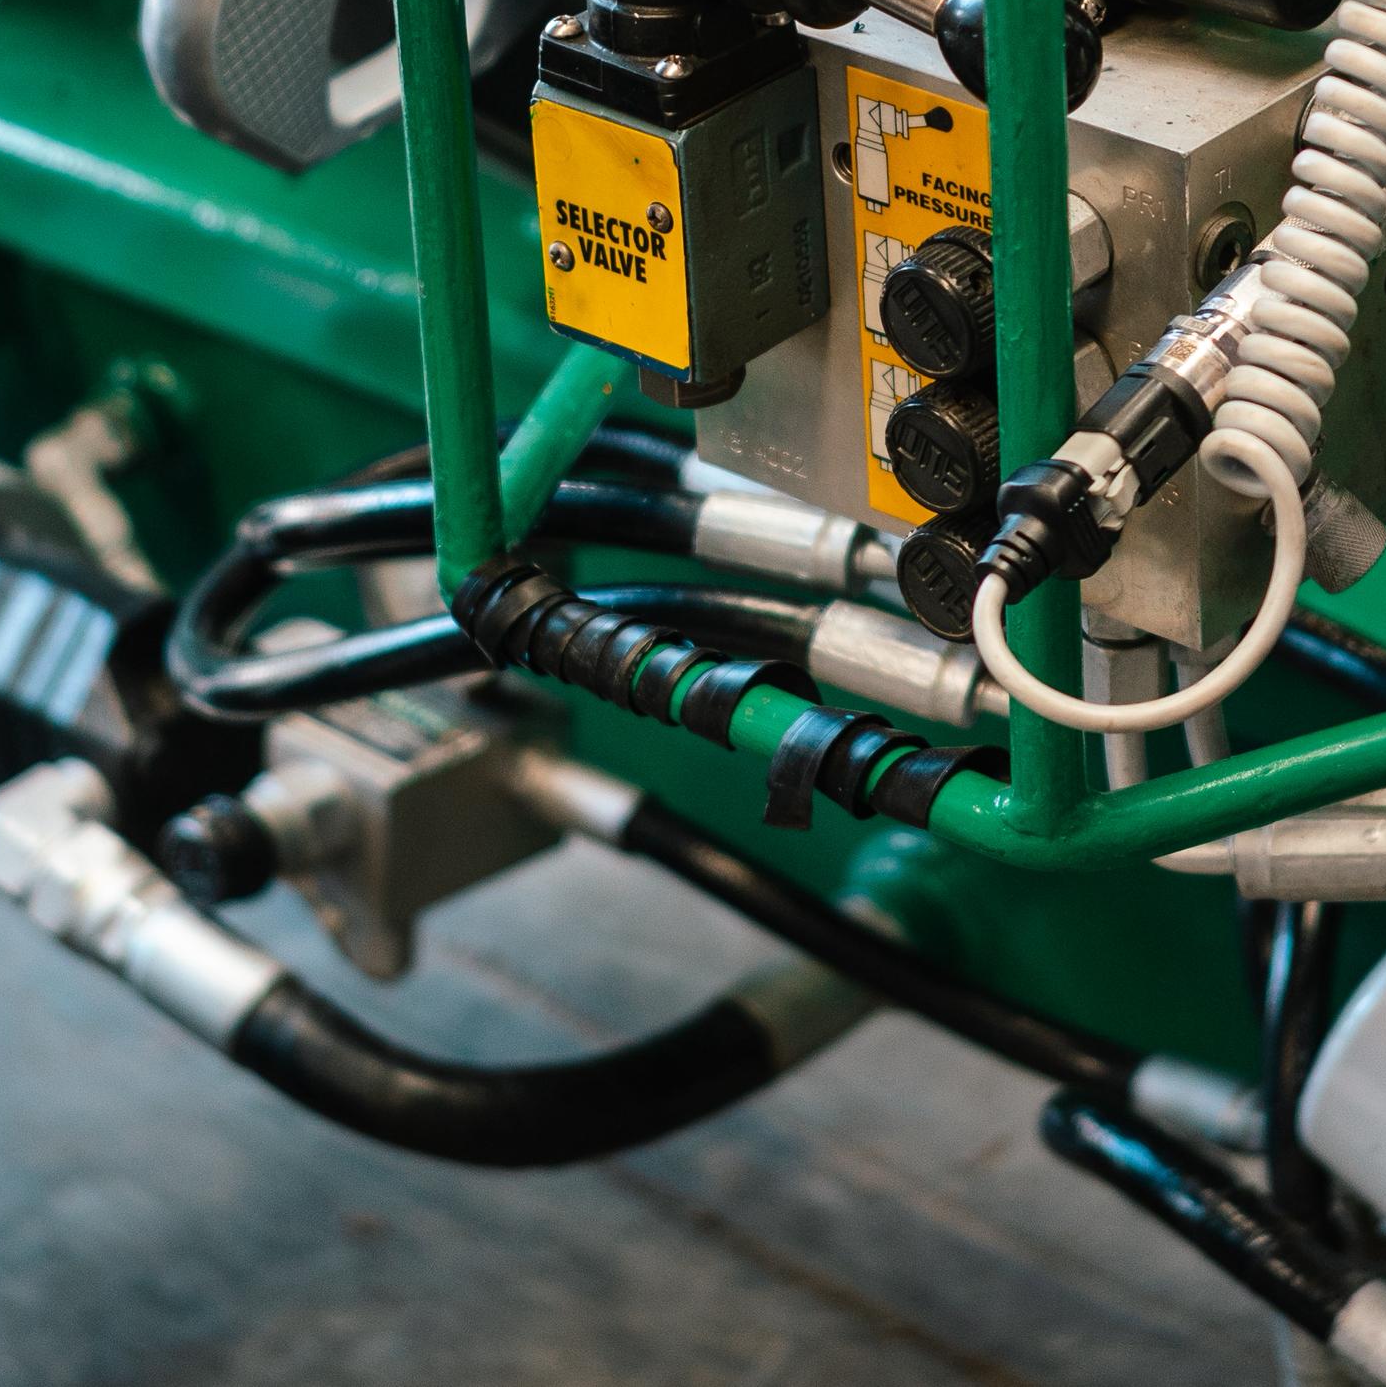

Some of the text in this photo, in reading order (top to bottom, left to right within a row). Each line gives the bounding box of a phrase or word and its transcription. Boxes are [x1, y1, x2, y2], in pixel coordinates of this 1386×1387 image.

[894, 185, 993, 231] PRESSURE
[921, 172, 993, 208] FACING
[556, 199, 667, 261] SELECTOR
[578, 235, 647, 284] VALVE
